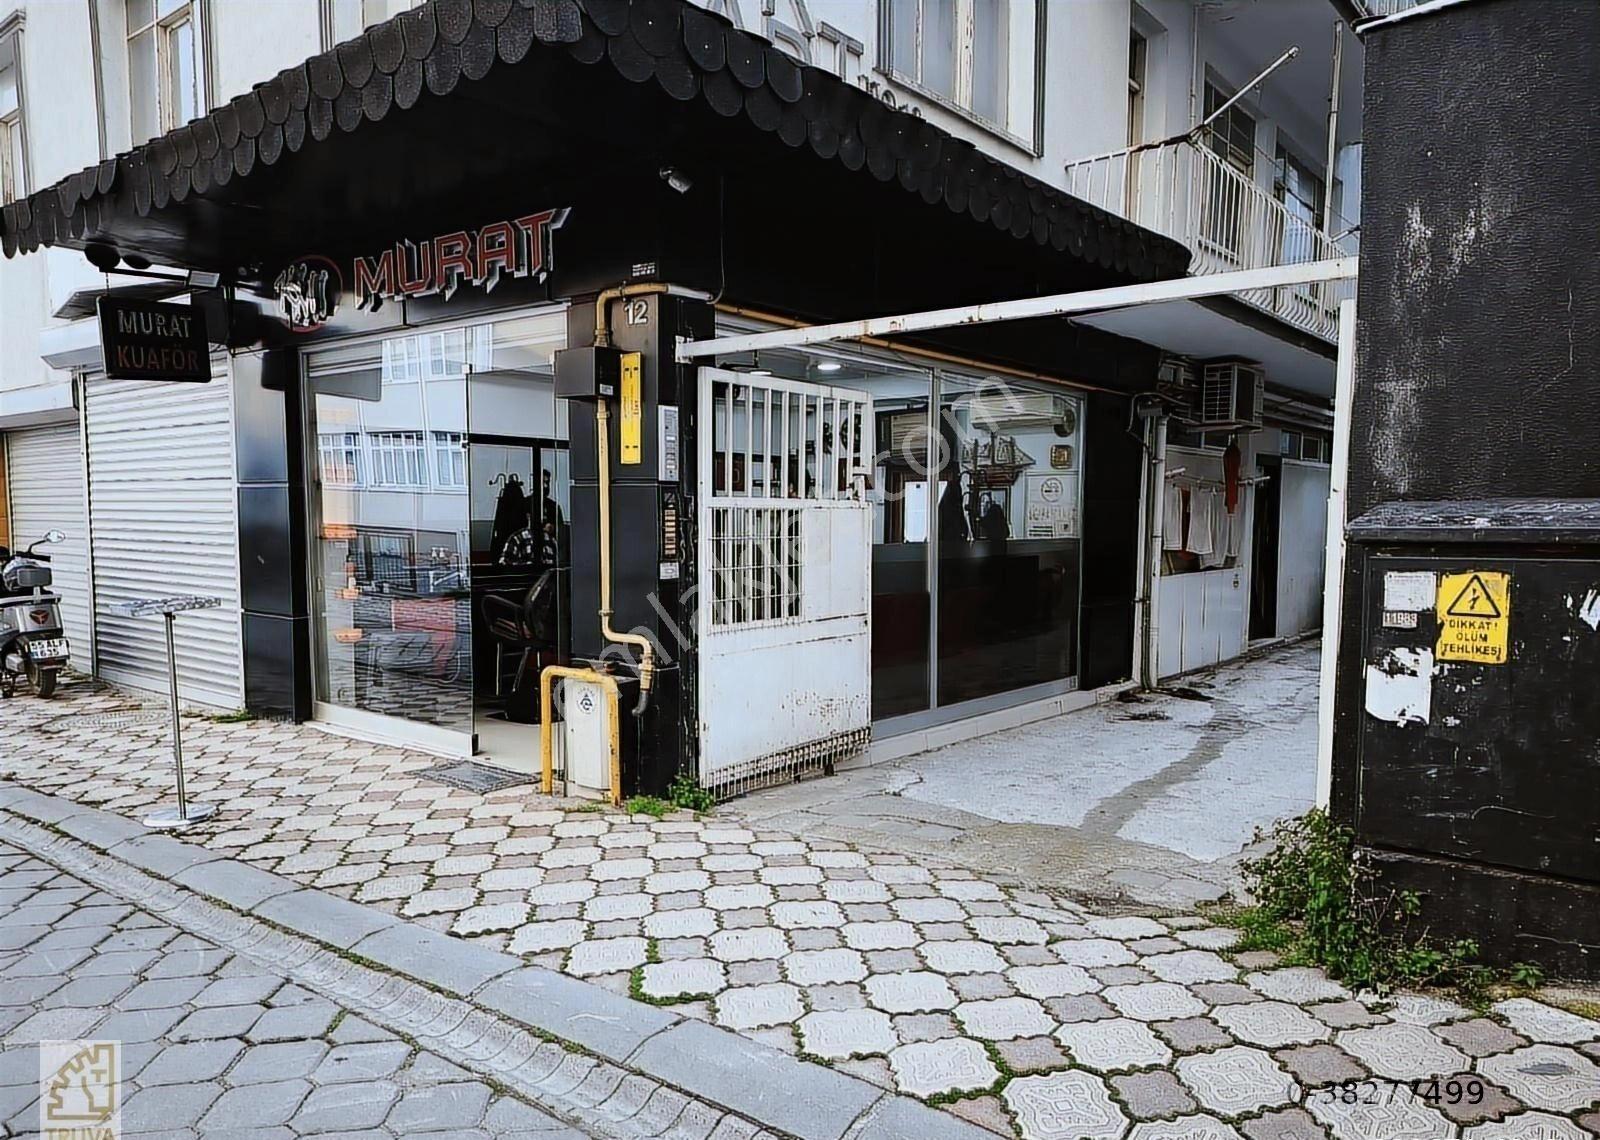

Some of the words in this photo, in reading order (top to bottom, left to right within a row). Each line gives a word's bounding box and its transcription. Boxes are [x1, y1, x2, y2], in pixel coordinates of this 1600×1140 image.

[354, 207, 571, 309] MURAT
[117, 310, 192, 338] MURAT
[624, 300, 648, 325] 12
[117, 344, 200, 371] KUAFÖR
